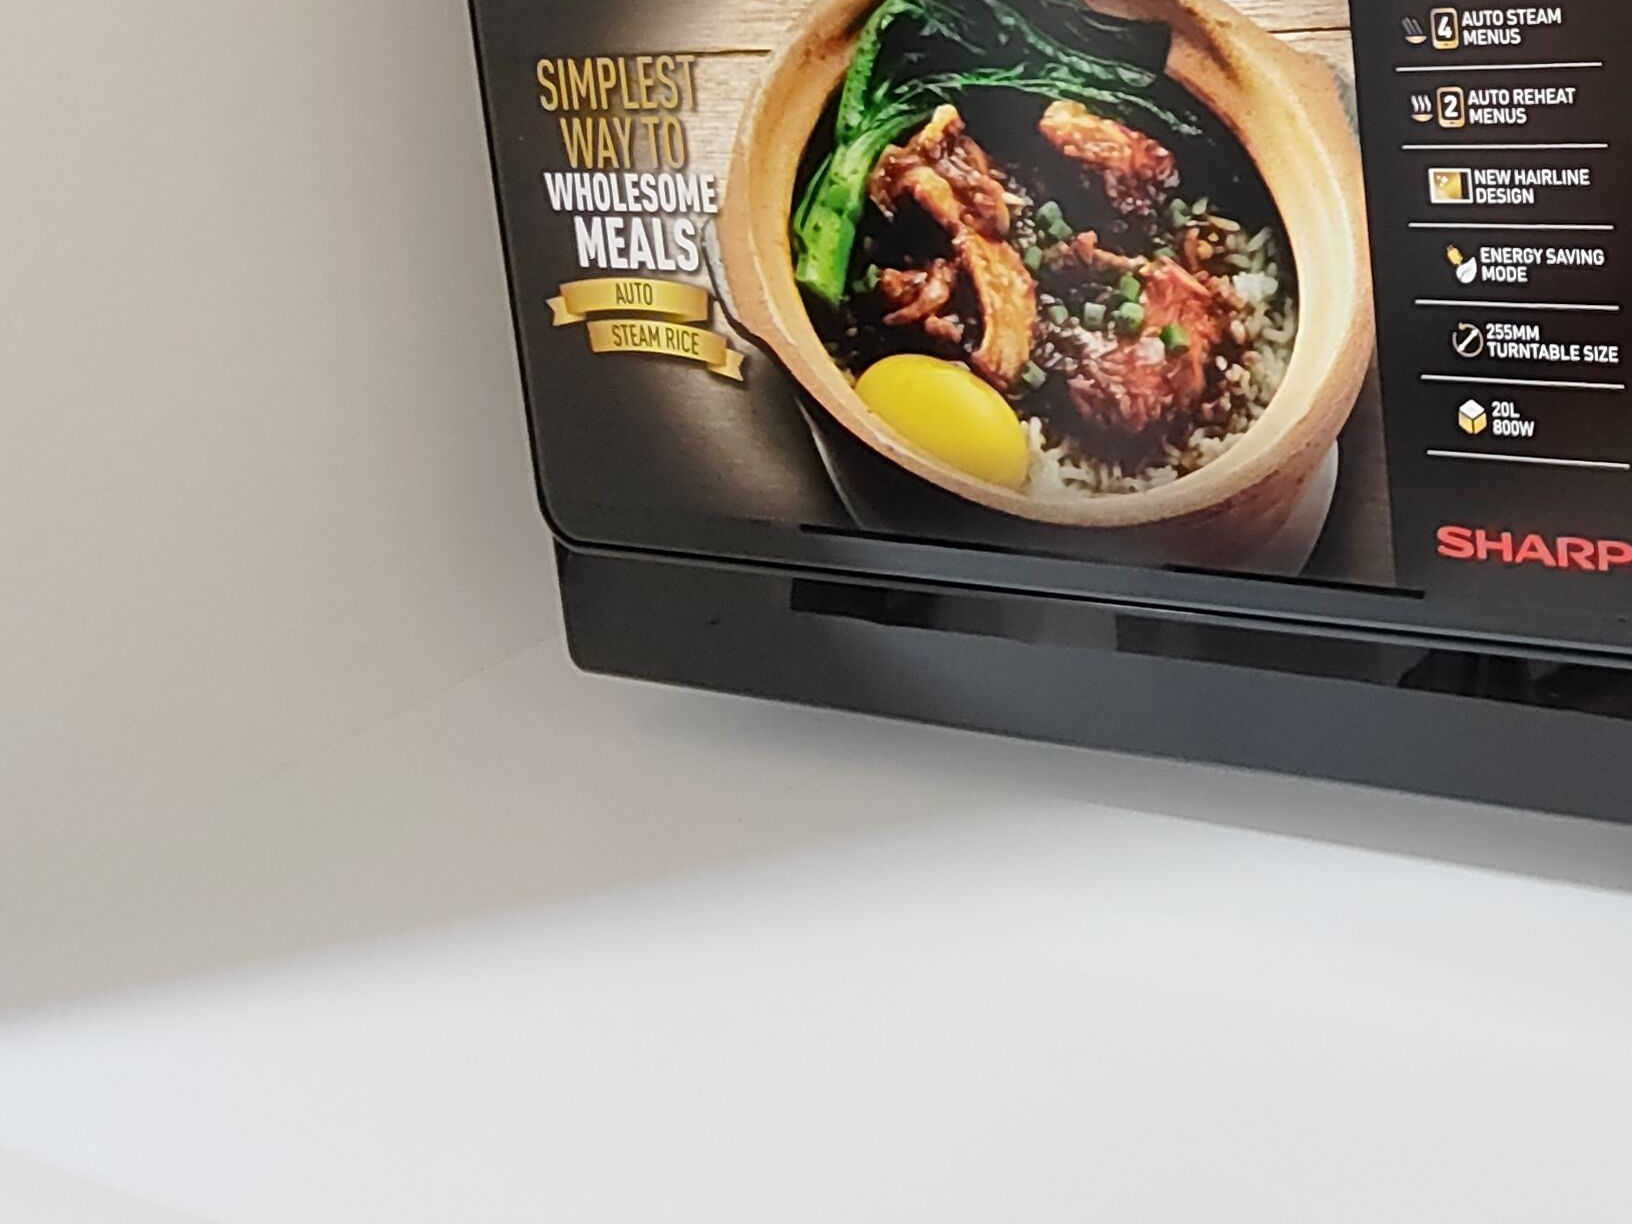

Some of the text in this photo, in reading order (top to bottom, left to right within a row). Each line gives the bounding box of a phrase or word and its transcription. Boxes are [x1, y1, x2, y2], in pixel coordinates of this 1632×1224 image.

[1461, 7, 1562, 27] AUTO STEAM
[1437, 15, 1454, 39] 4
[1463, 28, 1522, 46] MENUS
[536, 55, 697, 113] SIMPLEST
[1442, 94, 1460, 118] 2
[1467, 87, 1577, 106] AUTO REHEAT
[1469, 107, 1528, 125] MENUS
[559, 115, 687, 170] WAY TO
[1474, 169, 1591, 187] NEW HAIRLINE
[543, 172, 719, 214] WHOLESOME
[1476, 187, 1535, 205] DESIGN
[573, 215, 700, 272] MEALS
[1479, 247, 1606, 266] ENERGY SAVING
[1481, 266, 1529, 284] MODE
[614, 281, 654, 307] AUTO
[611, 324, 701, 356] STEAM RICE
[1486, 323, 1540, 342] 255MM
[1486, 342, 1619, 364] TURNTABLE SIZE
[1491, 401, 1521, 419] 20L
[1492, 419, 1536, 438] 800W
